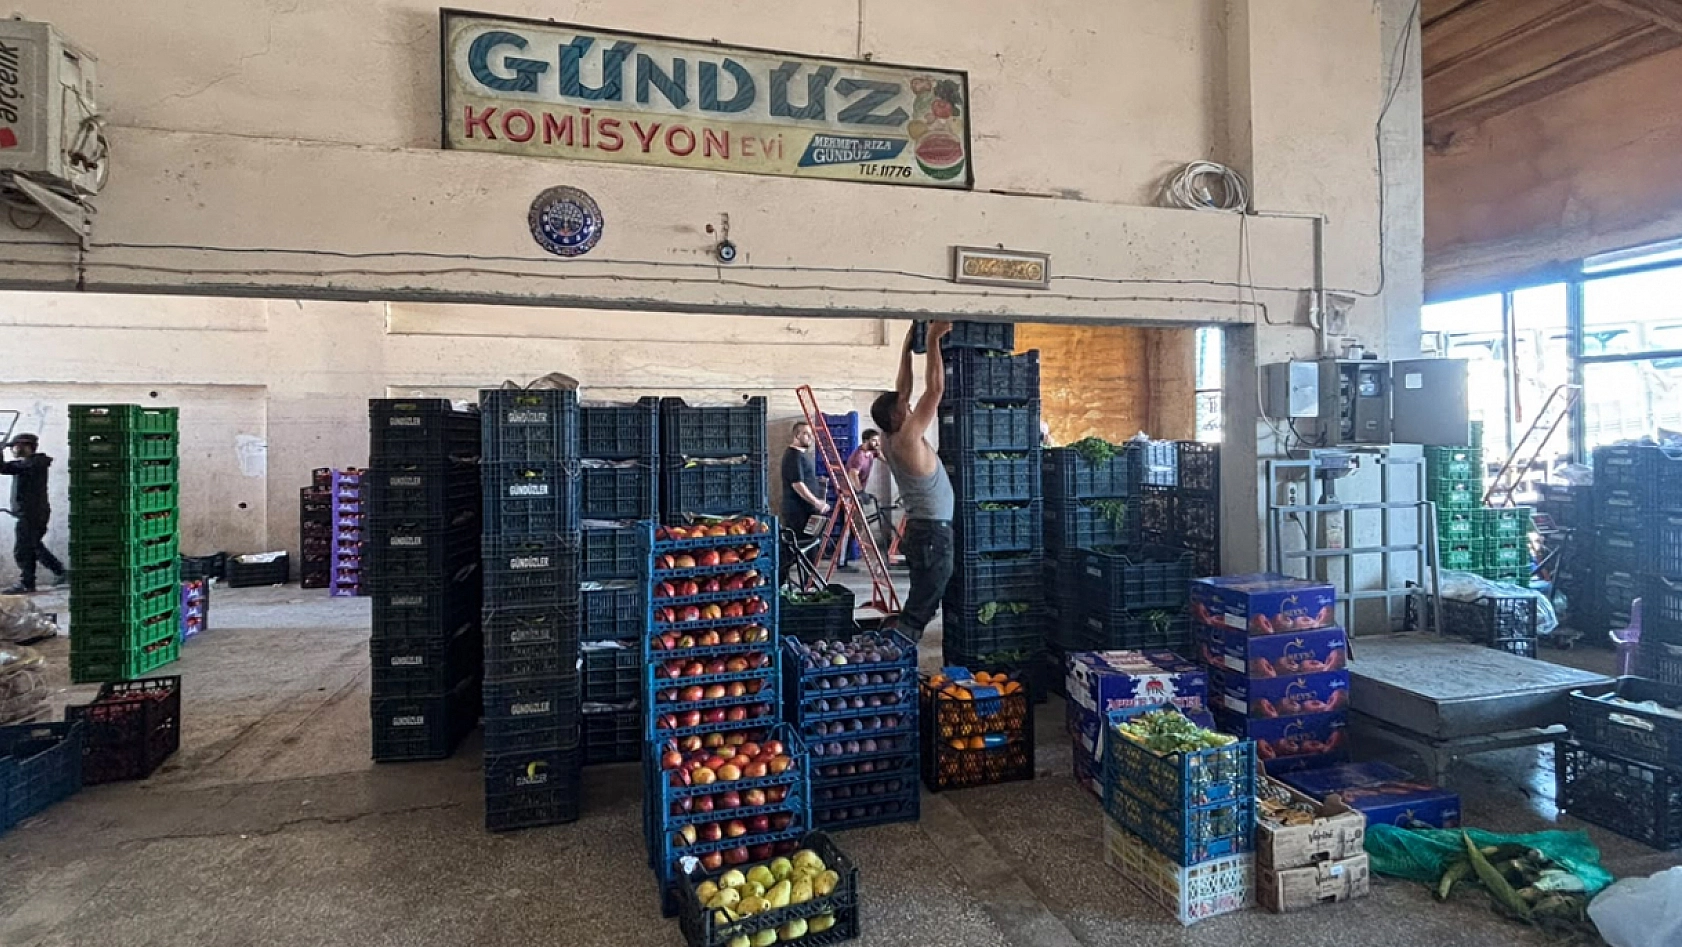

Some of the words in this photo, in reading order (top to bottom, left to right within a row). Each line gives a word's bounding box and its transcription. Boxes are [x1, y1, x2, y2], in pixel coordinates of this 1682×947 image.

[0, 41, 25, 124] arçelik
[468, 31, 910, 127] GÜNDÜZ
[463, 105, 729, 160] KOMİSYON
[811, 136, 861, 150] MEHMET
[863, 140, 892, 150] RIZA
